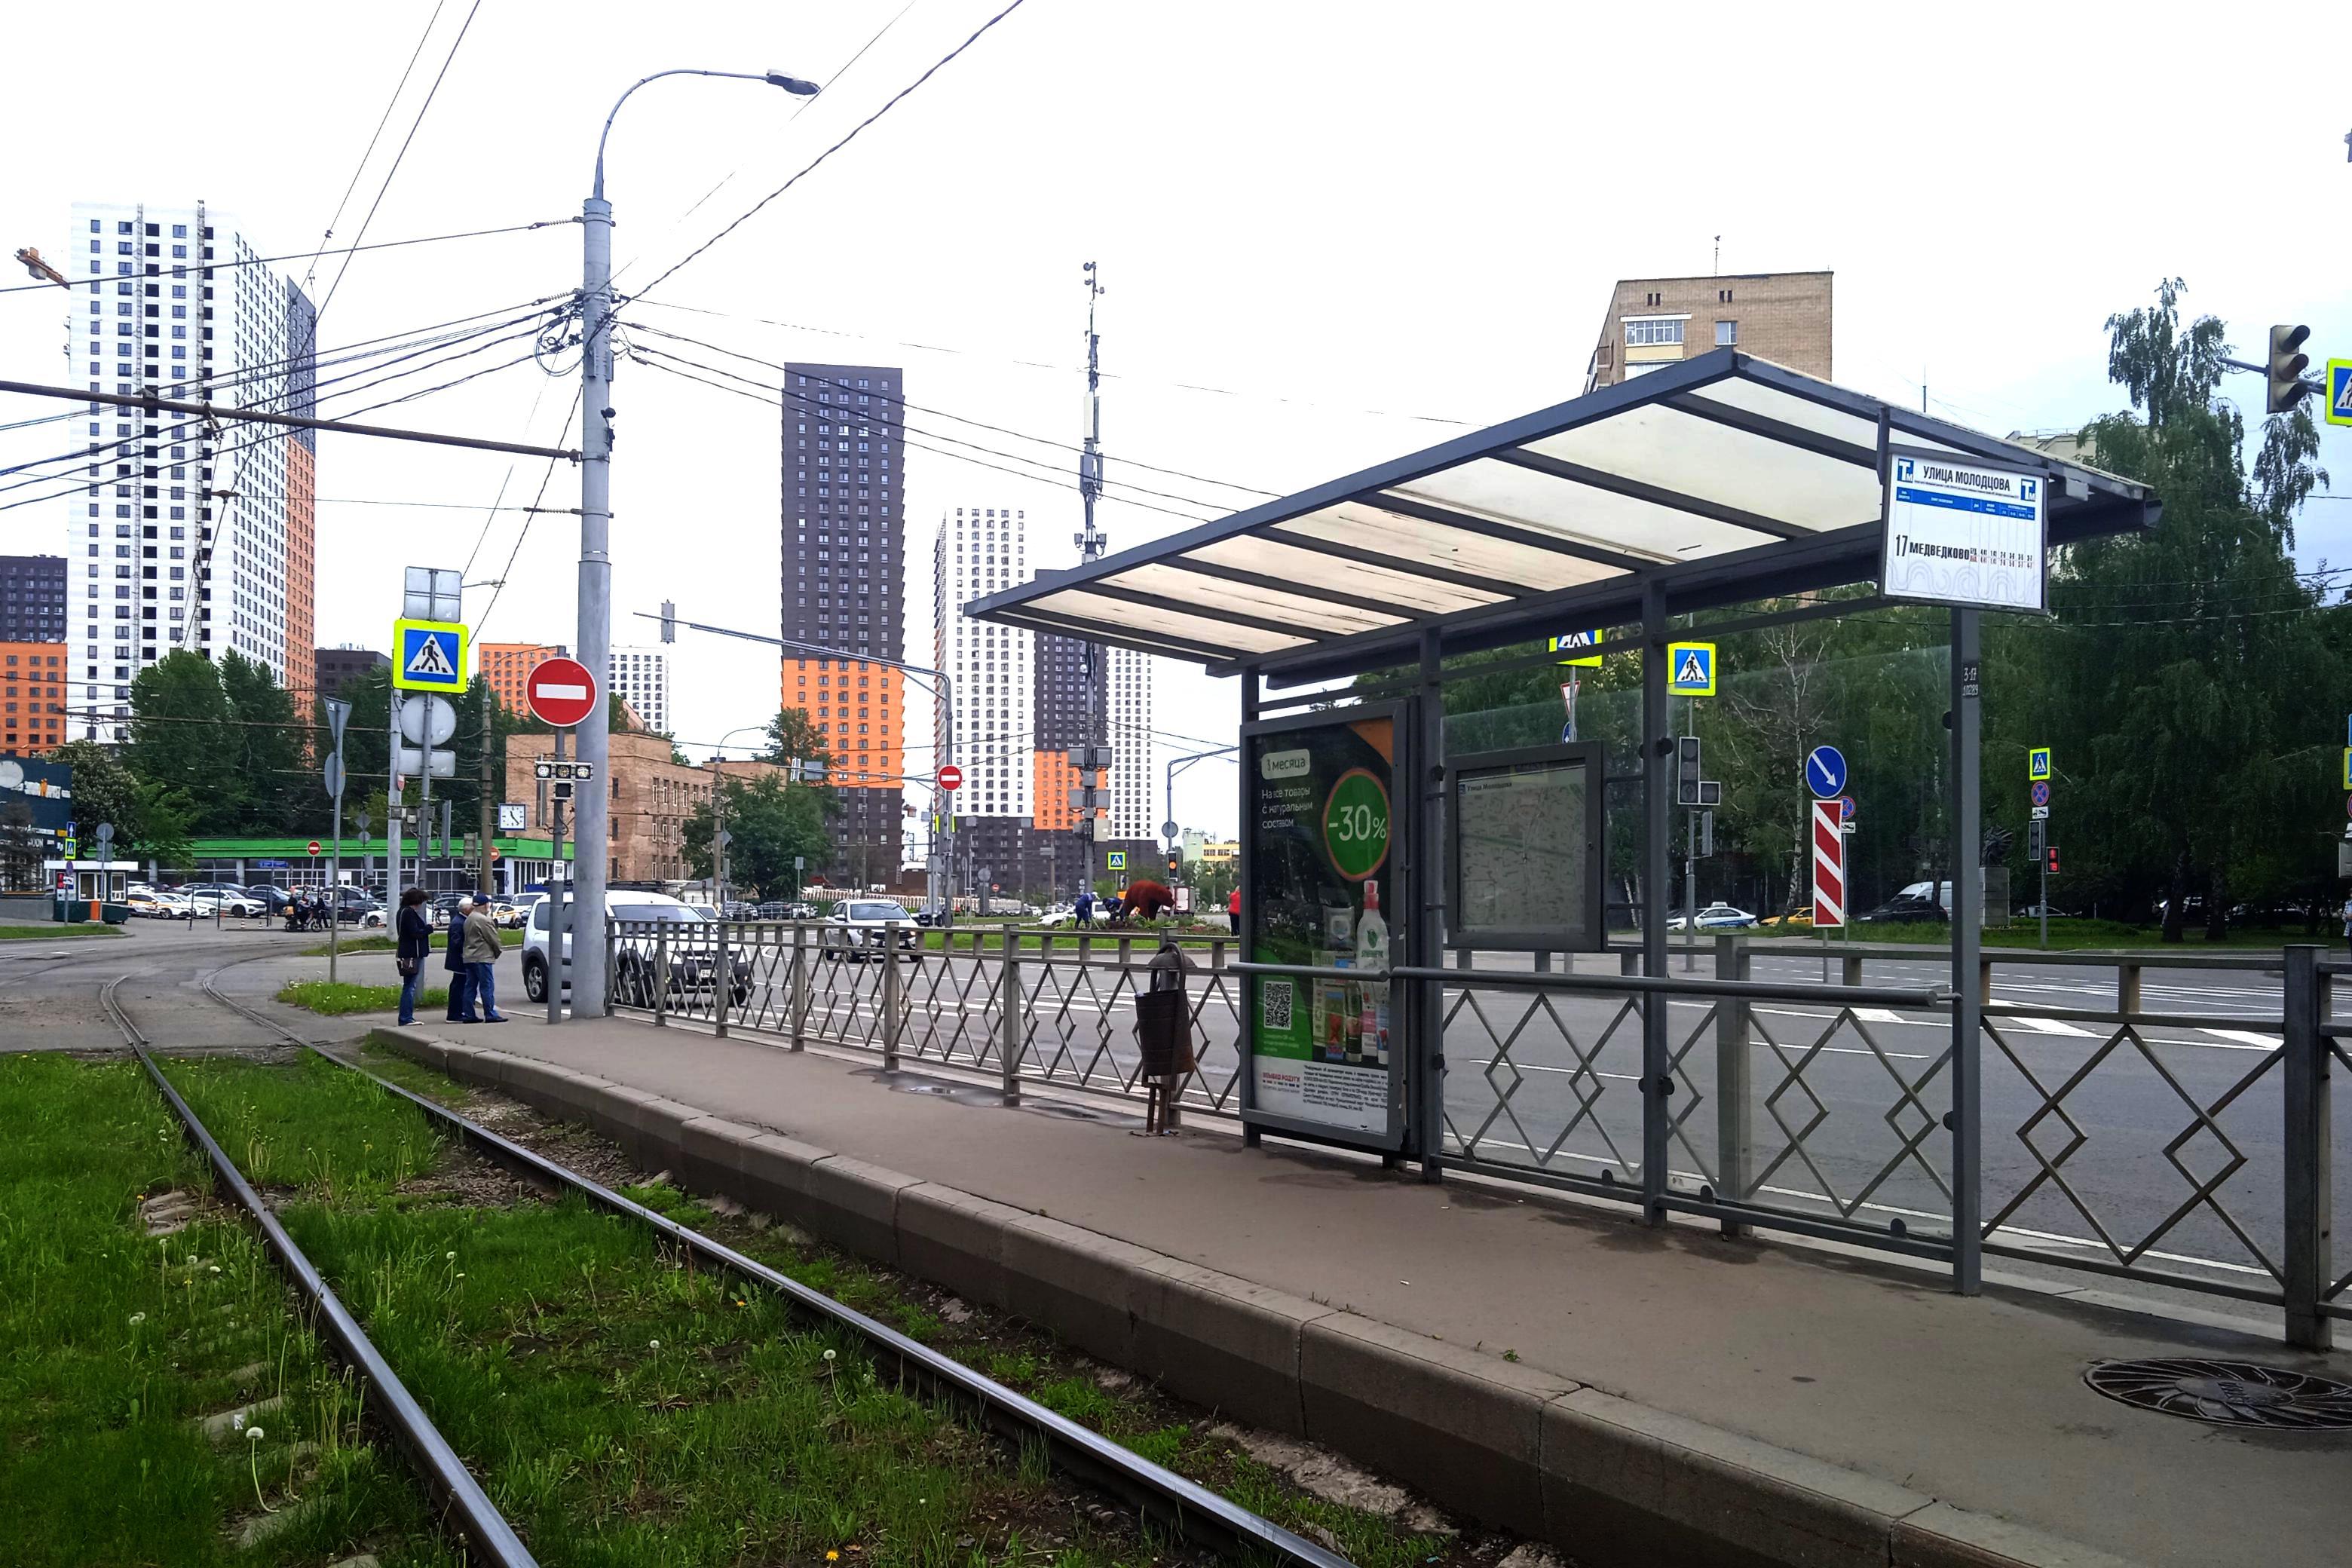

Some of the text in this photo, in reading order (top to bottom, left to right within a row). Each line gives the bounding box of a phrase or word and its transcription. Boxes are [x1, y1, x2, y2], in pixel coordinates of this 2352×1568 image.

[1923, 465, 1953, 485] УЛИЦА
[1955, 472, 2011, 492] МОЛОДЦОВА
[1895, 534, 1908, 556] 17
[1909, 541, 1970, 560] МЕДВЕДКОВО
[1272, 758, 1306, 770] месяца
[1262, 789, 1272, 799] На
